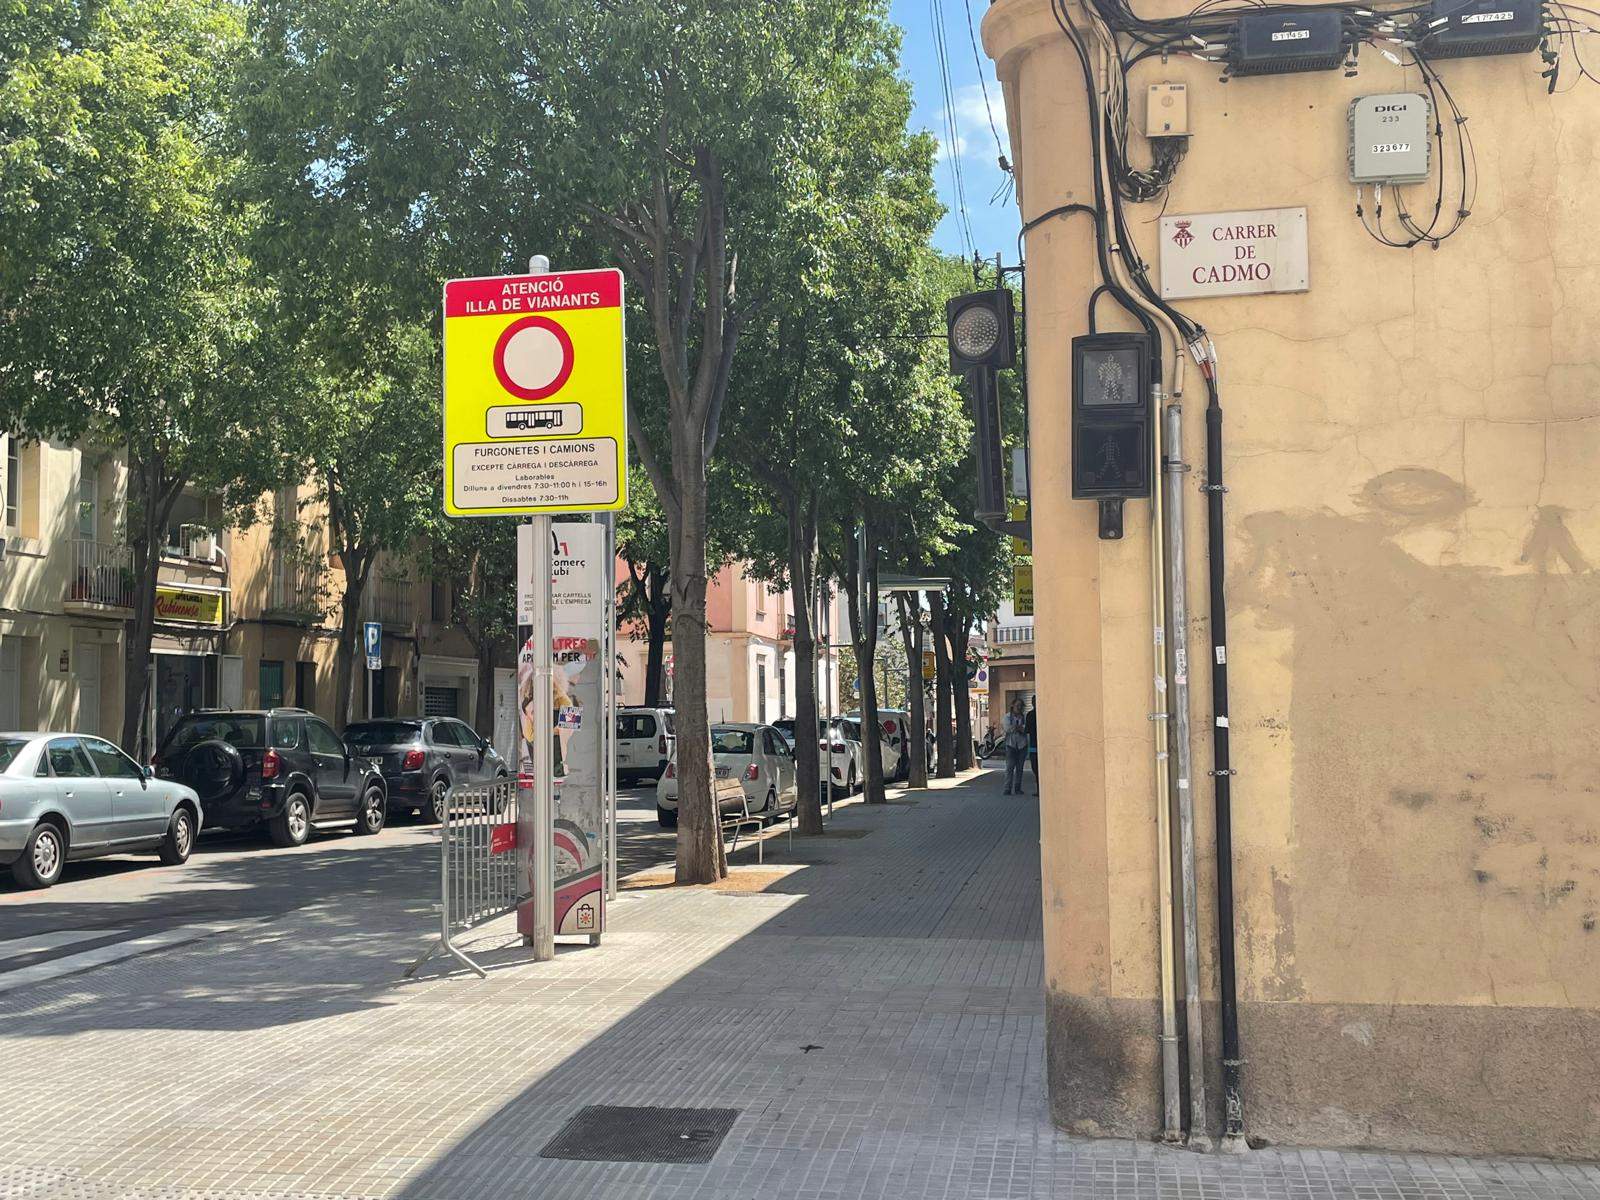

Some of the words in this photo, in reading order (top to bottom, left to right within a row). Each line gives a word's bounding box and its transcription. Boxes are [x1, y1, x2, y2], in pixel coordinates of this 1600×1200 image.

[1273, 31, 1308, 40] 511451
[1375, 104, 1407, 112] DIGI
[1373, 144, 1409, 152] 323677
[1212, 223, 1278, 241] CARRER
[1235, 245, 1257, 260] DE
[1192, 262, 1271, 284] CADMO
[501, 277, 564, 296] ATENCIÓ
[466, 300, 497, 313] ILLA
[502, 298, 521, 311] DE
[527, 292, 600, 309] VIANANTS
[474, 445, 540, 457] FURGONETES
[543, 445, 546, 454] I
[549, 443, 595, 455] CAMIONS
[471, 463, 504, 471] EXCEPTE
[549, 459, 599, 468] DESCÀRREGA
[515, 474, 555, 482] Laborables
[464, 484, 488, 492] Dilluns
[497, 482, 531, 490] divendres
[501, 495, 537, 503] Dissabtes
[552, 566, 569, 576] ubí
[561, 652, 581, 662] PER
